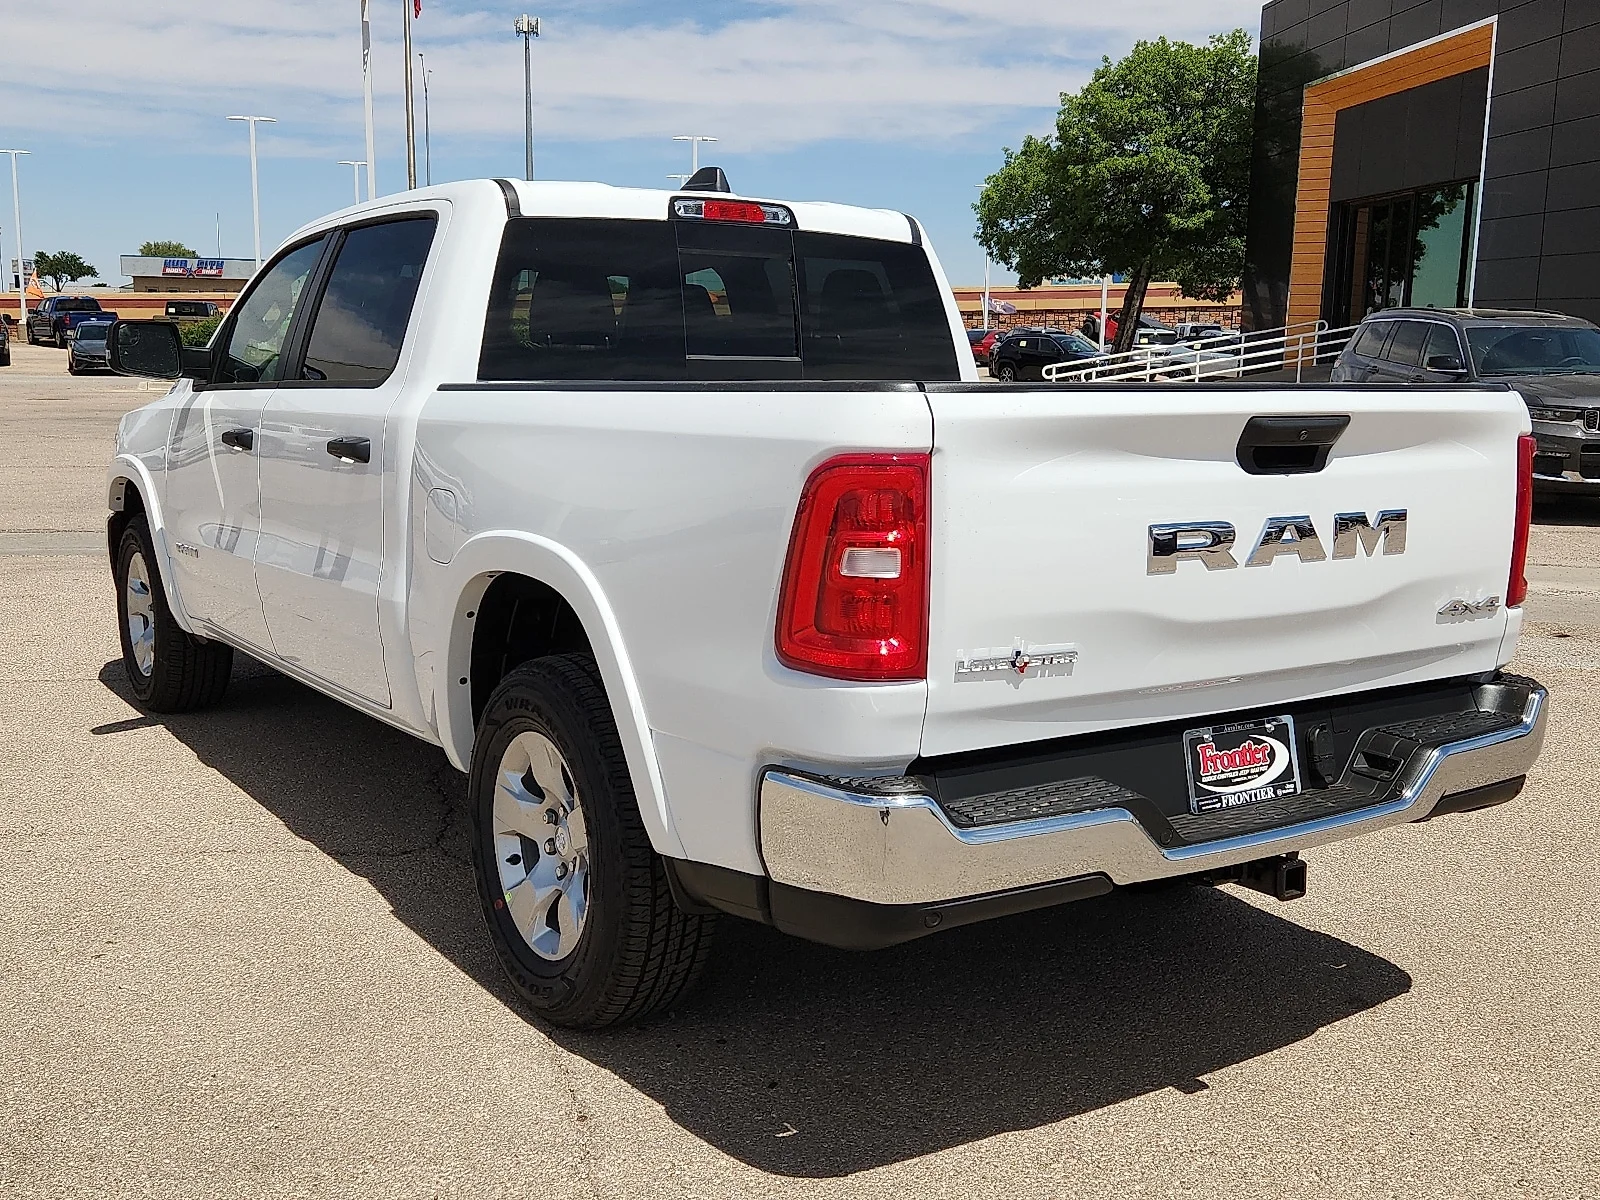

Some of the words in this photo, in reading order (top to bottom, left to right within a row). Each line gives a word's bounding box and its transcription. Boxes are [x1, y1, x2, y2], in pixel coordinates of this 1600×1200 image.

[1146, 508, 1408, 576] RAM
[954, 657, 1012, 675] LONE
[1026, 651, 1079, 667] STAR
[1198, 741, 1270, 775] Frontier
[1221, 786, 1275, 808] FRONTIER
